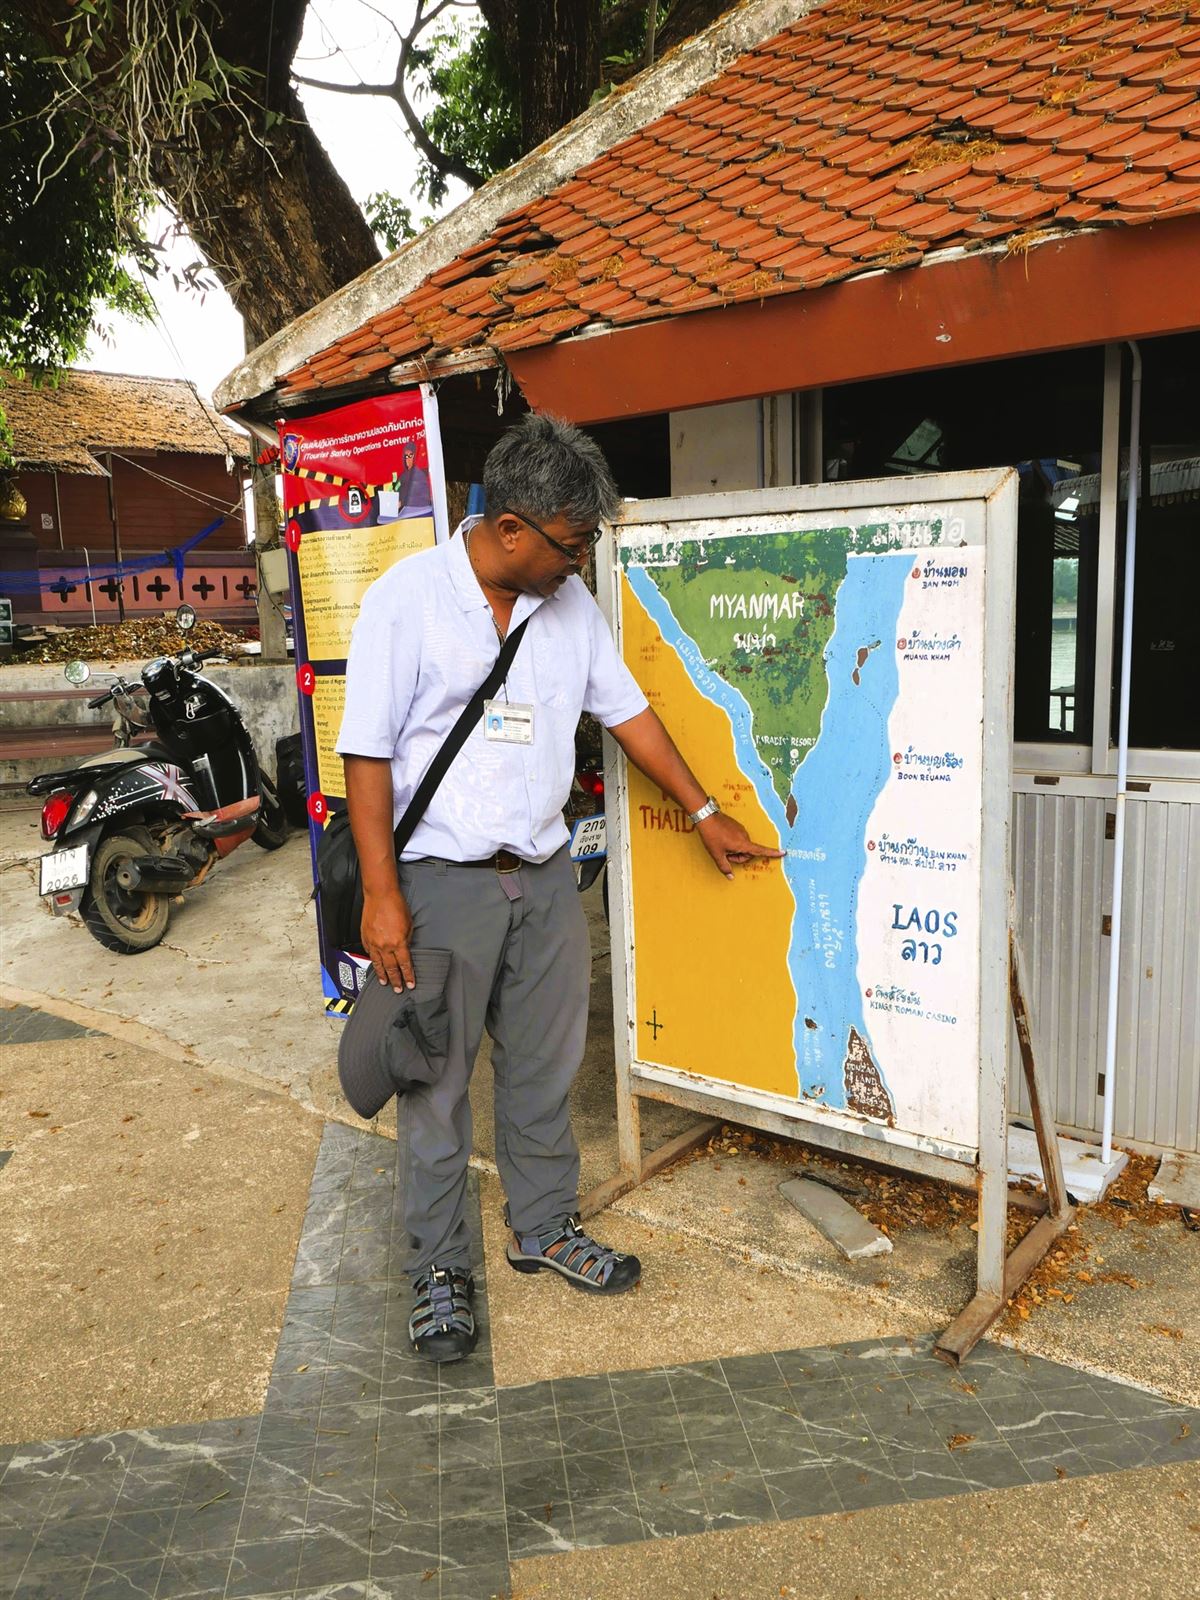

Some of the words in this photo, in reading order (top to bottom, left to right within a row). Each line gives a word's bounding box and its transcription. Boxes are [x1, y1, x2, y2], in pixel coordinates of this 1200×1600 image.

[383, 436, 410, 447] Center
[291, 530, 296, 539] 1
[923, 559, 968, 578] บ้านมอม
[710, 591, 805, 623] MYANMAR
[304, 673, 311, 686] 2
[897, 772, 918, 780] BOON
[315, 801, 322, 812] 3
[577, 843, 598, 857] 109
[47, 873, 79, 892] 2026
[891, 904, 958, 938] LAOS
[901, 939, 942, 965] ลาว
[870, 1000, 893, 1012] KINGS
[895, 1004, 924, 1018] ROMAN
[925, 1011, 957, 1025] CASINO
